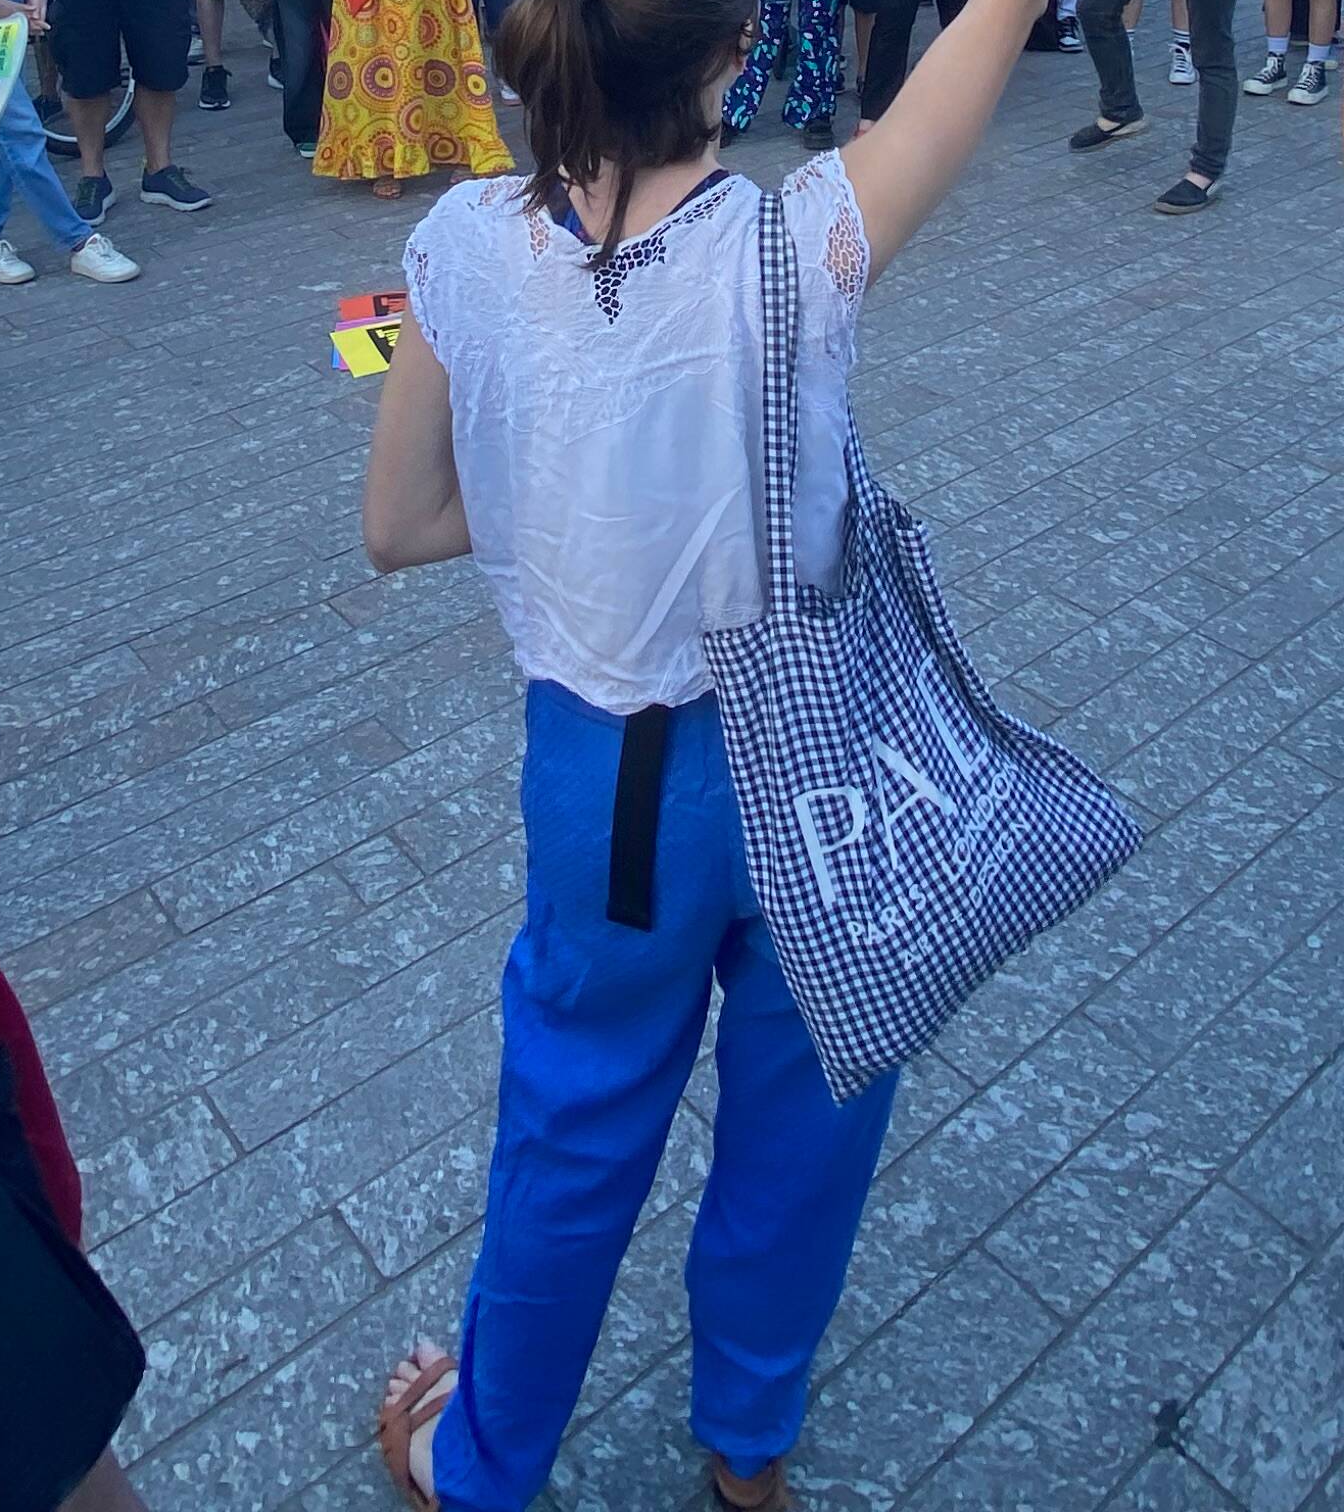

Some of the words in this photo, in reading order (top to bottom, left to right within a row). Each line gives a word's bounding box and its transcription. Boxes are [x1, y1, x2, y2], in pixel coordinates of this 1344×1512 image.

[793, 650, 989, 911] PAL
[847, 883, 927, 945] PARIS
[904, 922, 947, 971] ART
